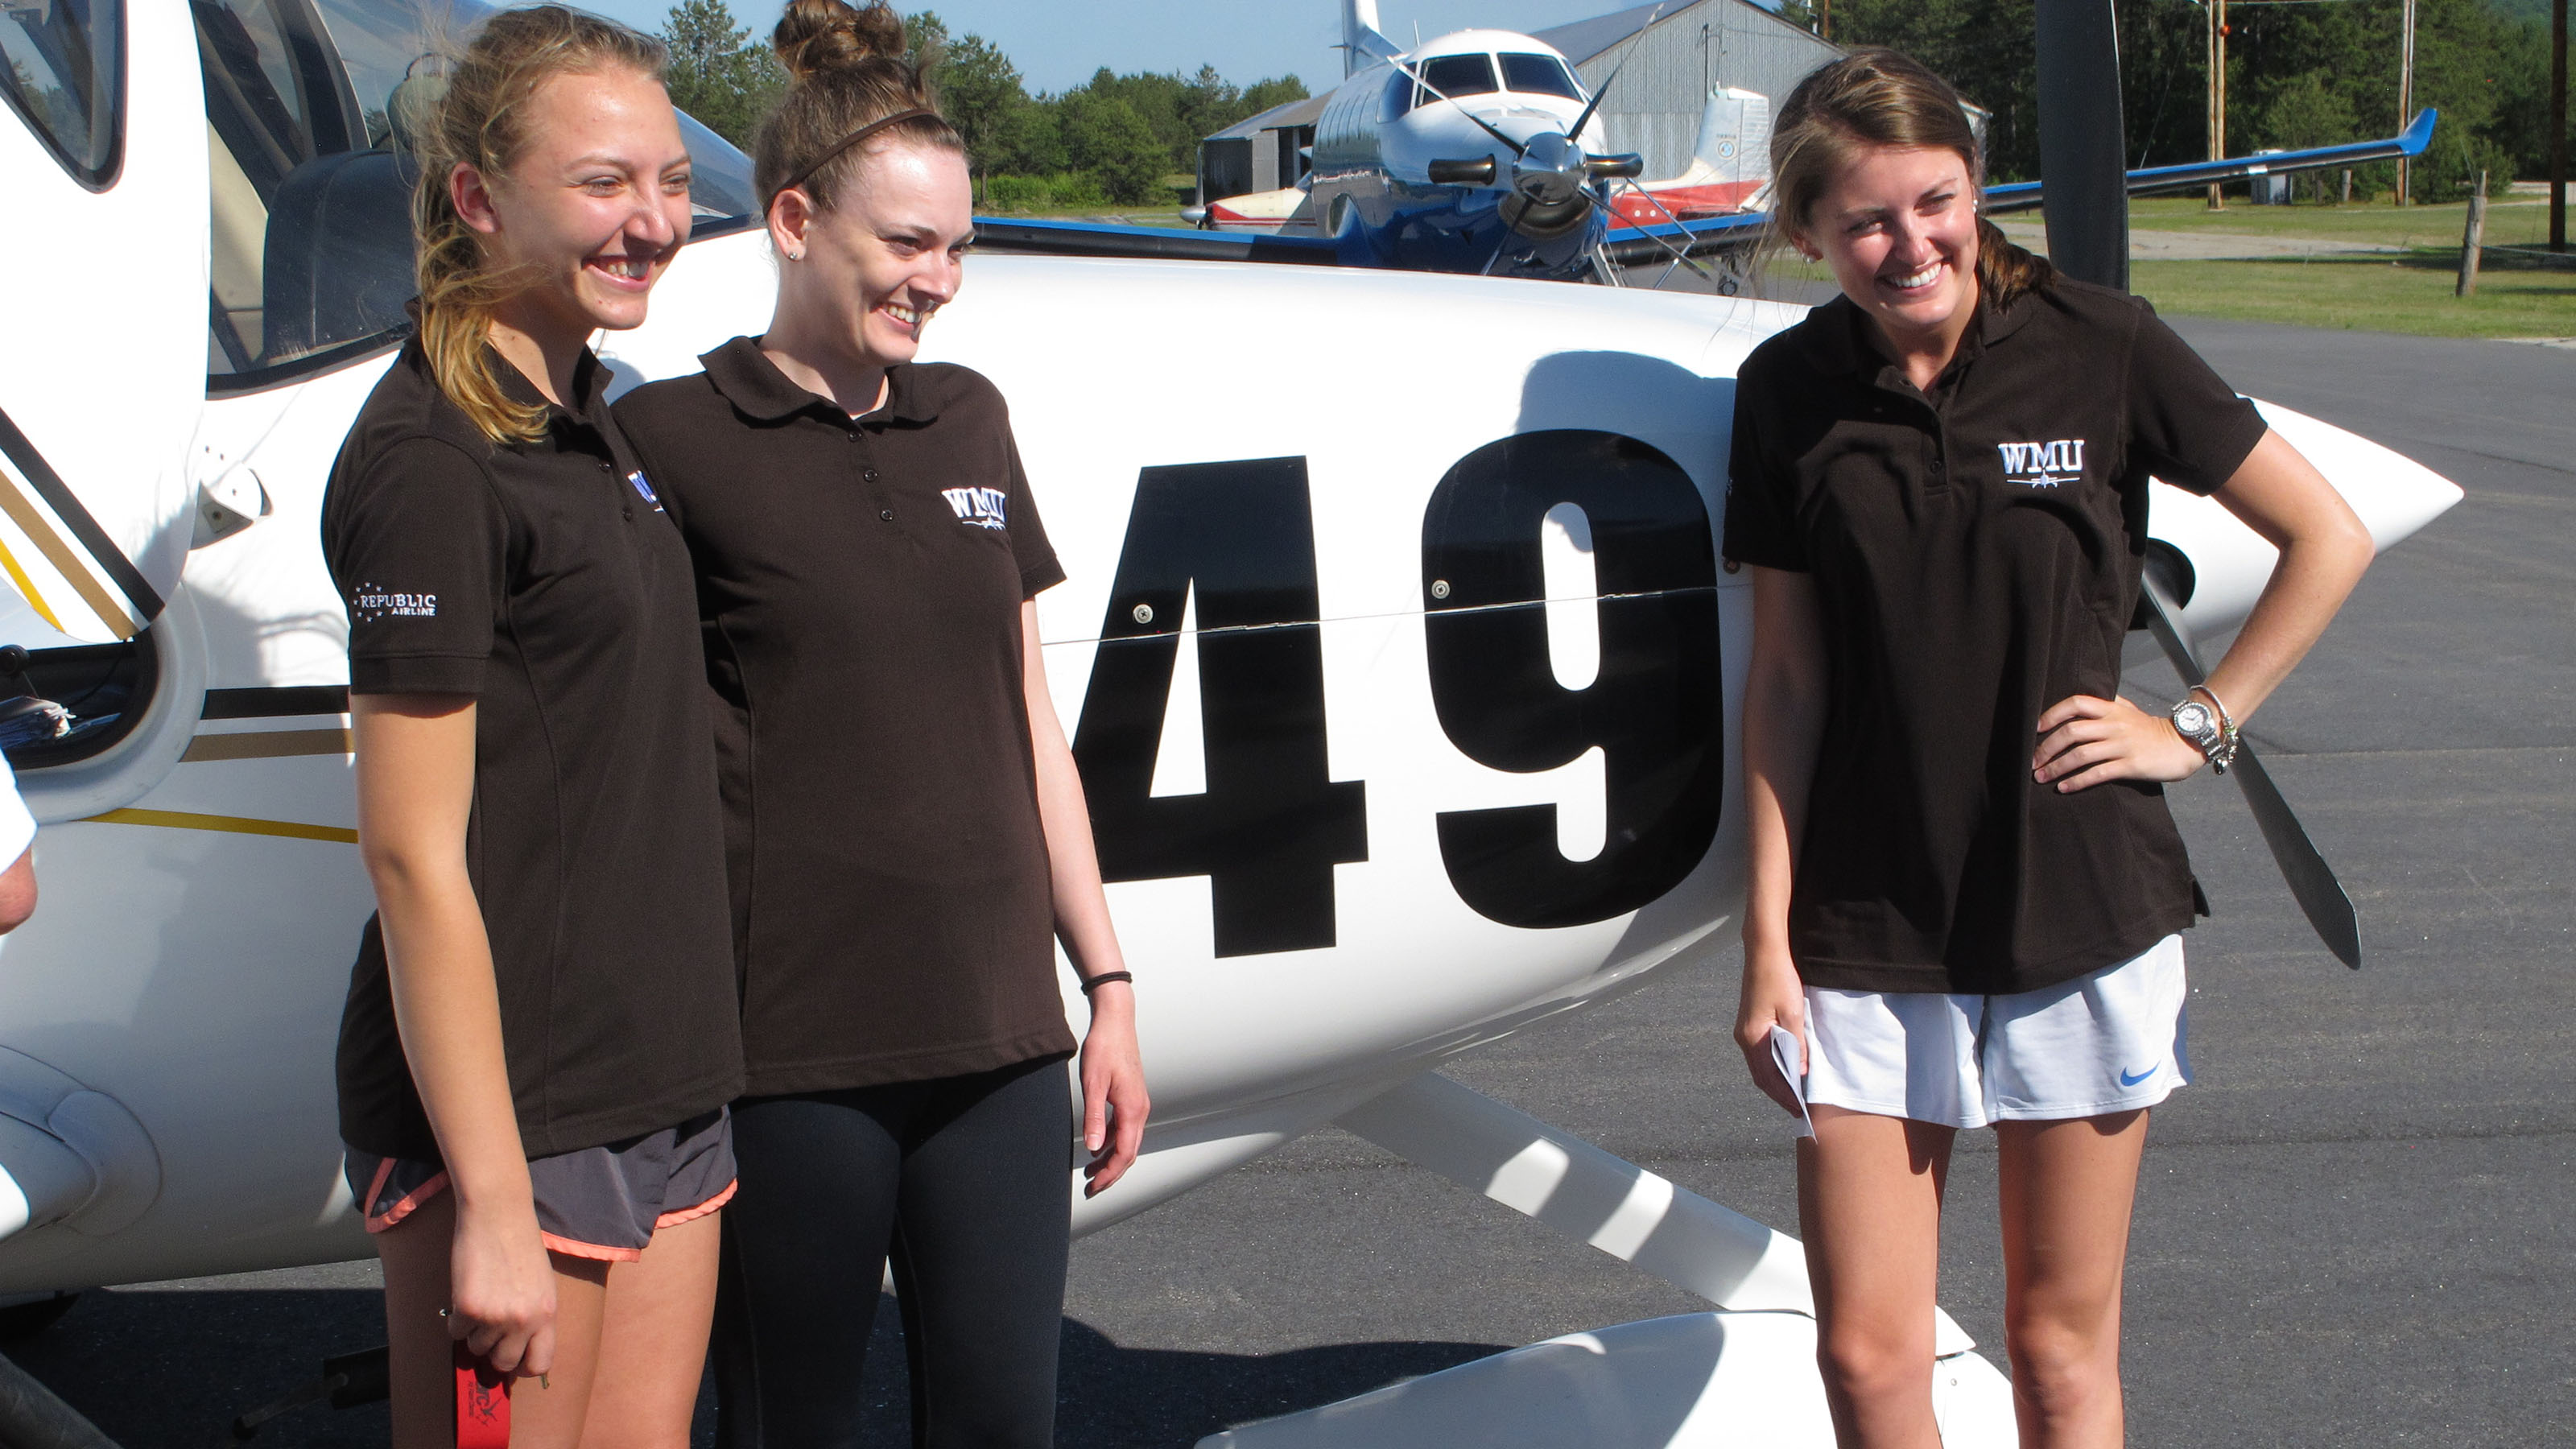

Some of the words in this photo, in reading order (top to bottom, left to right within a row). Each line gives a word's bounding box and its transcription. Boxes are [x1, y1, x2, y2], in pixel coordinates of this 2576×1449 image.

[1997, 440, 2085, 473] WMU
[941, 487, 1005, 522] WMU
[360, 593, 436, 609] REPUBLIC
[391, 607, 436, 617] AIRLINE
[1071, 427, 1724, 959] 49
